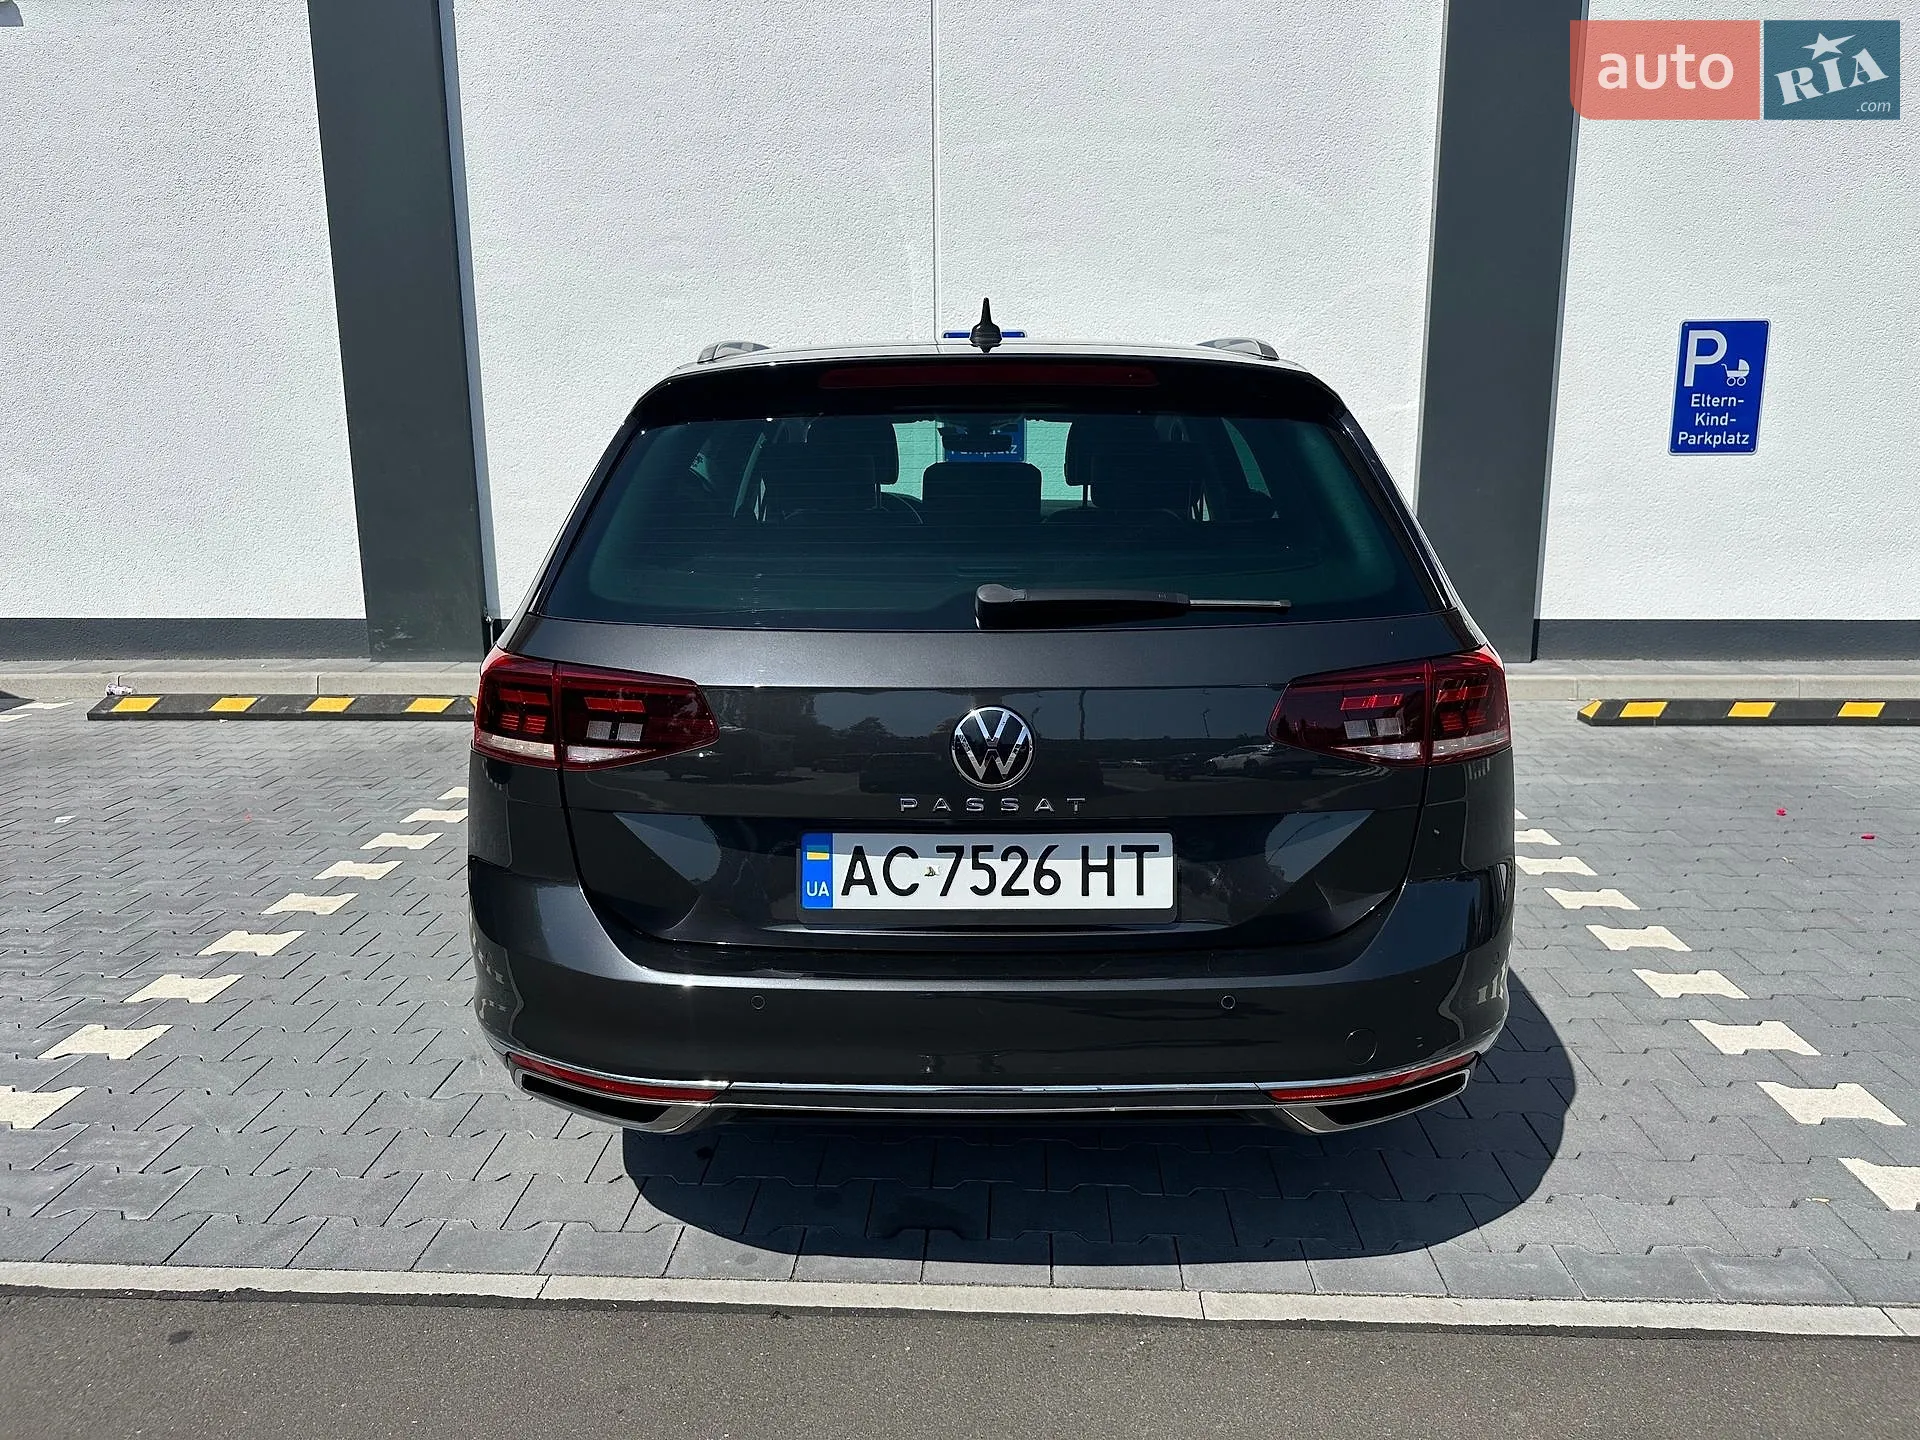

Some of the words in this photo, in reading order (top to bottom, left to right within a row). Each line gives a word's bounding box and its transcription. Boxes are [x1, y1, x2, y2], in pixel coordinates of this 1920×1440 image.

[1684, 330, 1727, 387] P
[1691, 394, 1744, 407] Eltern-
[1695, 412, 1736, 426] Kind-
[1678, 431, 1749, 448] Parkplatz
[900, 798, 1086, 812] PASSAT
[841, 845, 919, 896] AC
[936, 844, 1061, 896] 7526
[1081, 844, 1160, 896] HT
[806, 881, 829, 896] UA
